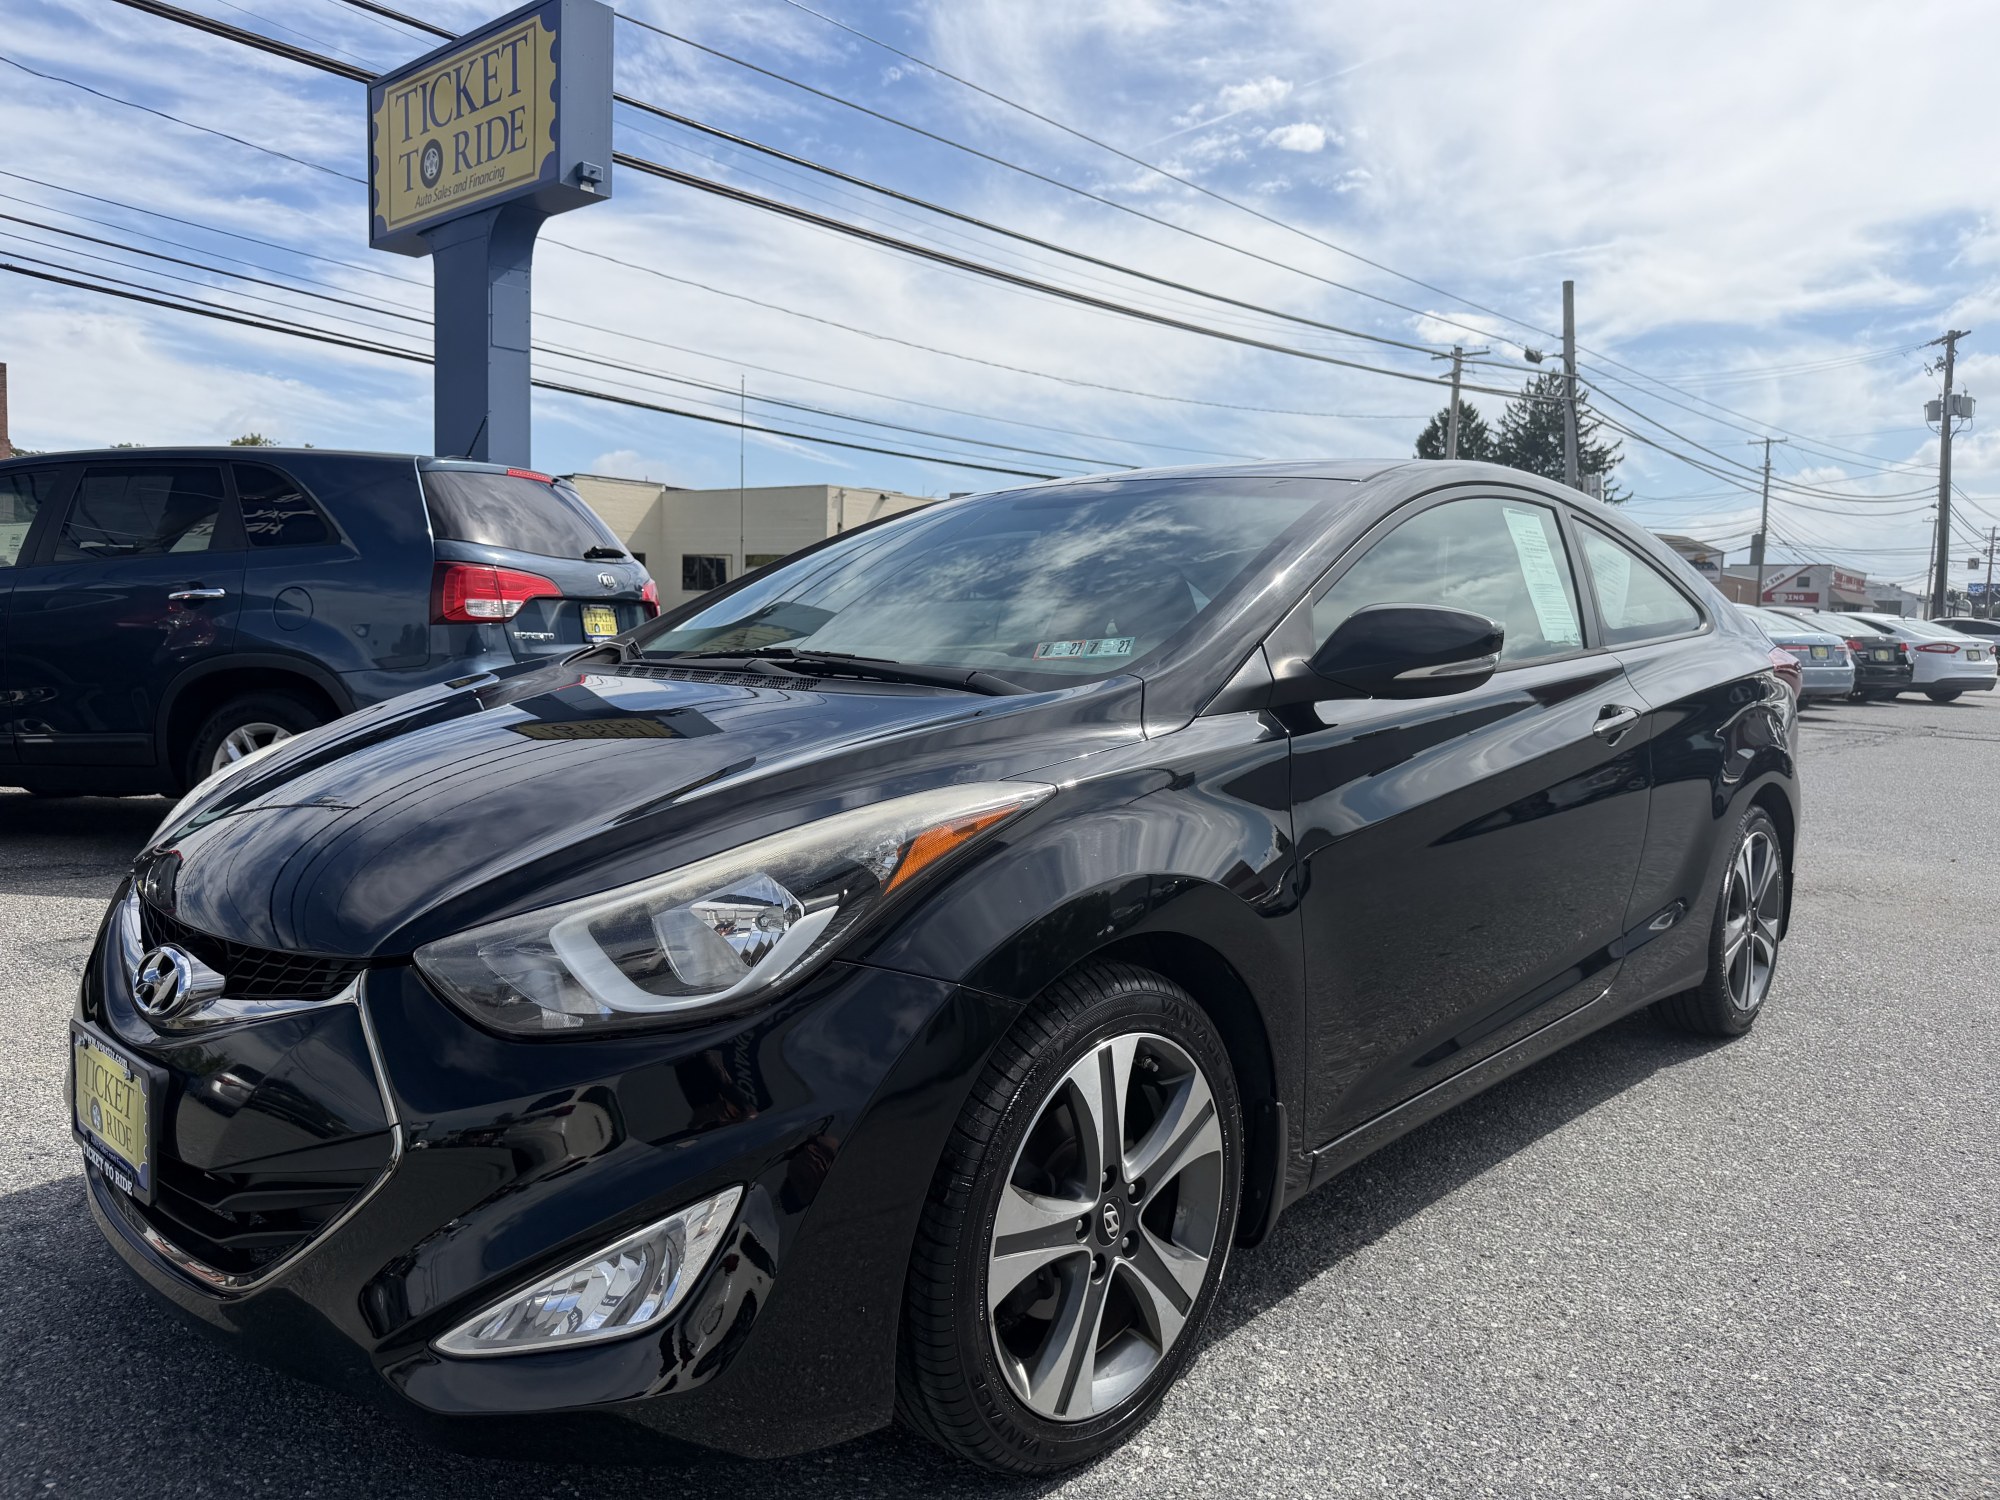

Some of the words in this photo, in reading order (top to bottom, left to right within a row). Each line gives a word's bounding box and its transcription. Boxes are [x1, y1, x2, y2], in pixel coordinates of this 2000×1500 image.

[395, 31, 529, 144] TICKET
[398, 138, 444, 193] TO
[452, 105, 528, 176] RIDE
[414, 193, 434, 209] Auto
[433, 183, 452, 203] Sales
[453, 177, 467, 195] and
[468, 165, 506, 191] Financing
[1068, 642, 1083, 656] 27
[1117, 639, 1131, 653] 27
[83, 1052, 135, 1120] TICKET
[83, 1089, 104, 1135] TO
[106, 1109, 134, 1156] RIDE
[82, 1139, 104, 1171] TICKET
[104, 1160, 114, 1180] TO
[115, 1170, 133, 1196] RIDE
